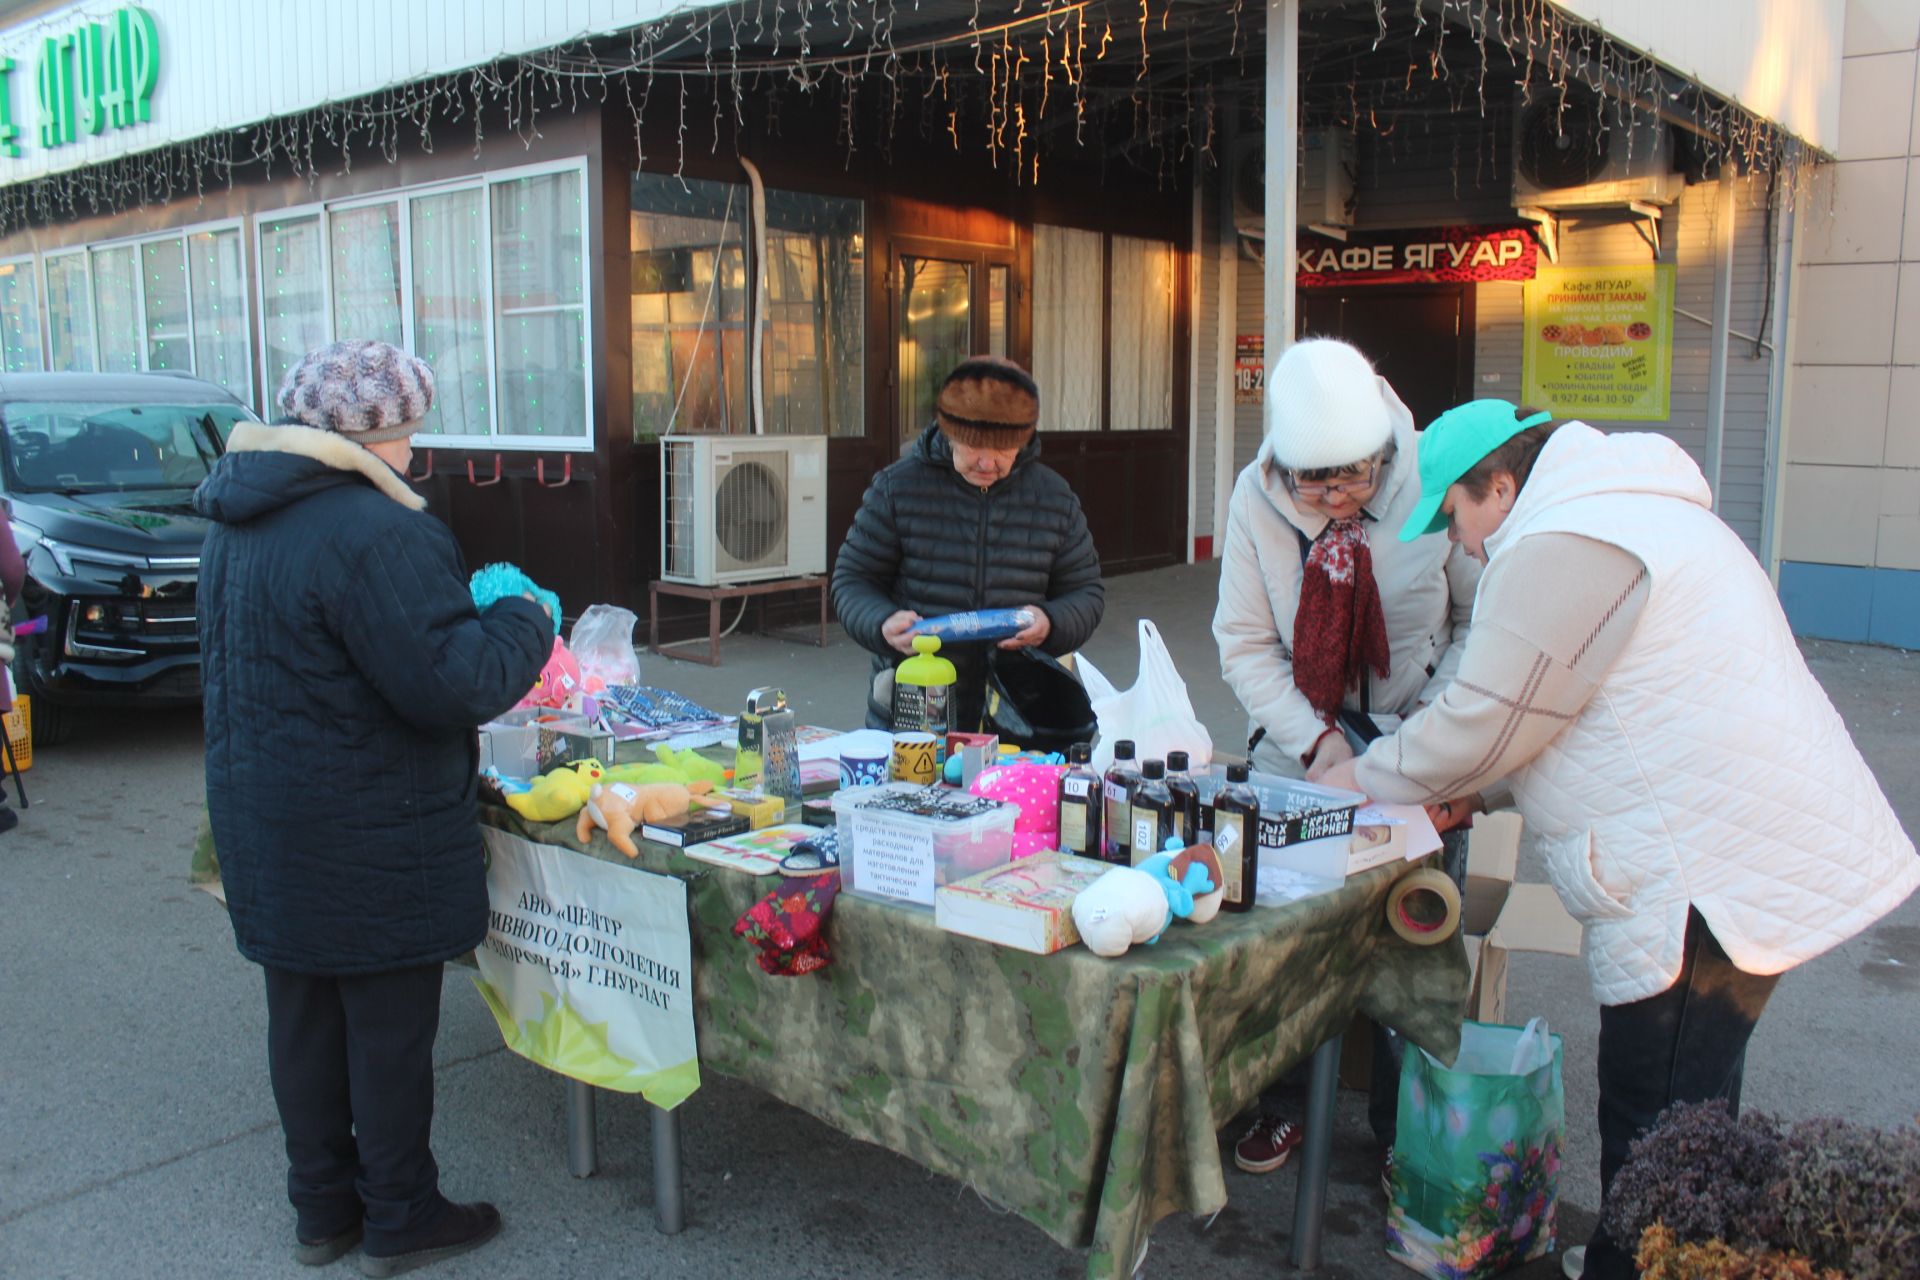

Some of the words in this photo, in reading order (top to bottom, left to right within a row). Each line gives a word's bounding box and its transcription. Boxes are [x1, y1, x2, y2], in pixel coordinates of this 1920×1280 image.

[1296, 246, 1394, 273] КАФЕ
[1403, 239, 1523, 270] ЯГУАР
[1563, 282, 1591, 293] Кафе
[1595, 280, 1632, 291] ЯГУАР
[1547, 293, 1606, 303] ПРИНИМАЕТ
[1609, 291, 1647, 302] ЗАКАЗЫ
[1554, 346, 1633, 358] ПРОВОДИМ
[1574, 362, 1615, 371] СВАДЬБЫ
[1235, 368, 1264, 390] 18-2
[856, 824, 887, 835] средств
[899, 832, 930, 846] покупку
[872, 838, 914, 852] расходных
[863, 849, 908, 862] материалов
[909, 857, 924, 866] для
[867, 860, 920, 876] изготовления
[870, 871, 917, 887] тактических
[877, 885, 910, 897] изделий
[518, 891, 551, 916] АНО
[557, 904, 622, 936] «ЦЕНТР
[490, 909, 558, 947] ИВНОГО
[557, 932, 681, 989] ДОЛГОЛЕТИЯ
[588, 965, 670, 1010] Г.НУРЛАТ
